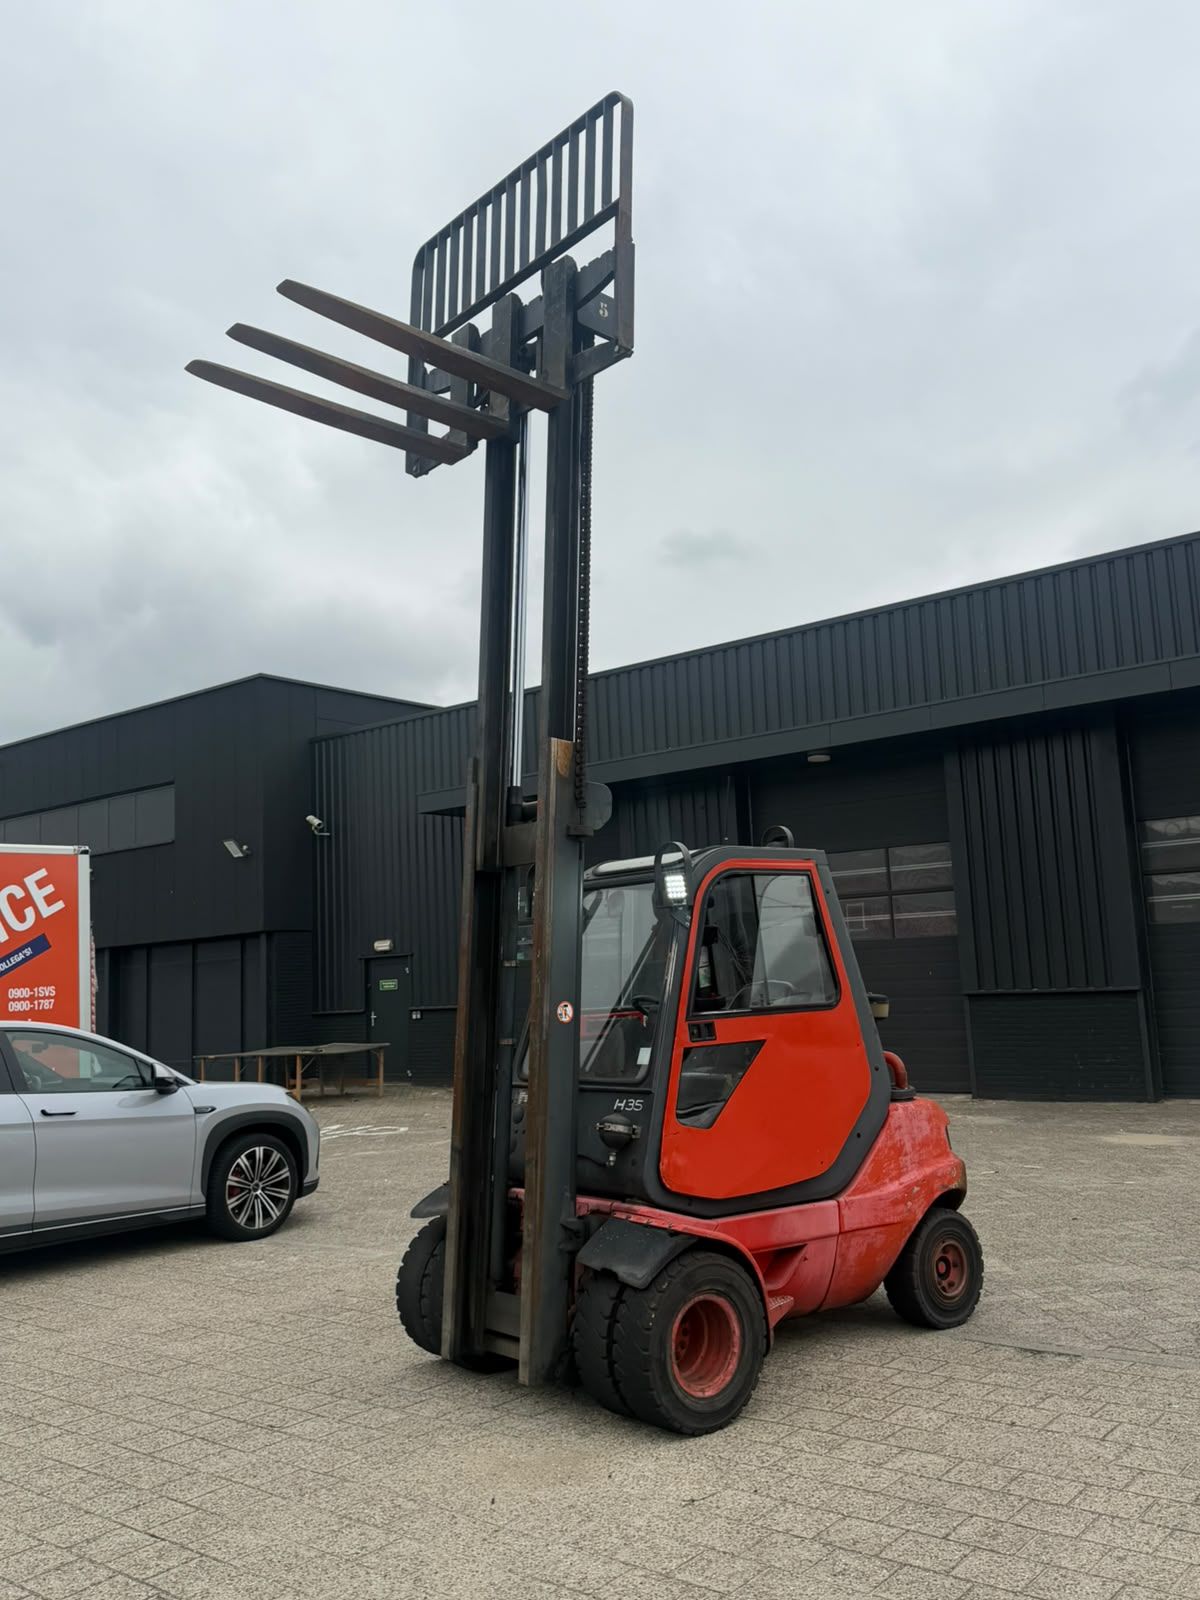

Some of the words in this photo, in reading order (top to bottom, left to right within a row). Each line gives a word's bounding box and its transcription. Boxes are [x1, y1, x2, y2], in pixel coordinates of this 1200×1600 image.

[599, 302, 609, 318] 5
[8, 986, 56, 999] 0900-1SVS
[8, 999, 55, 1012] 0900-1787
